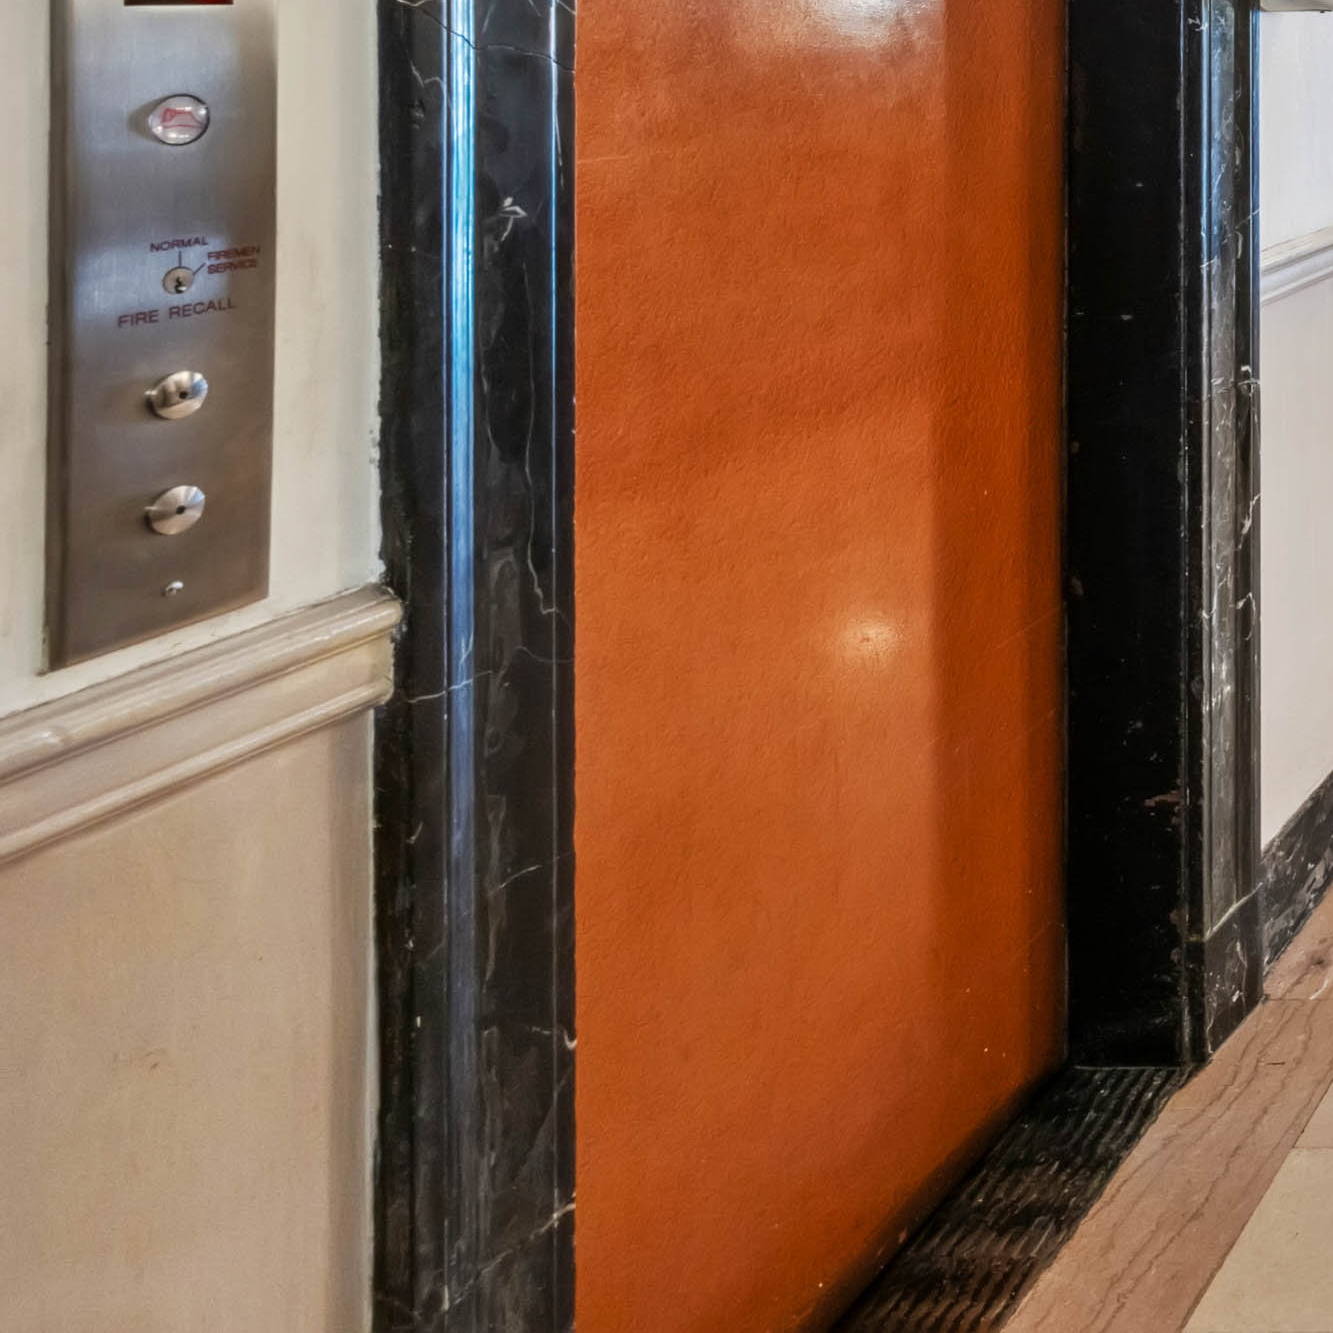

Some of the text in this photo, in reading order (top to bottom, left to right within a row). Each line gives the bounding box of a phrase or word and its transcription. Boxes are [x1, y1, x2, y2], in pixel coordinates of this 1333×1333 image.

[150, 236, 209, 252] NORMAL
[207, 246, 261, 260] FIREMEN
[207, 260, 257, 275] SERVICE
[117, 298, 237, 329] FIRE RECALL
